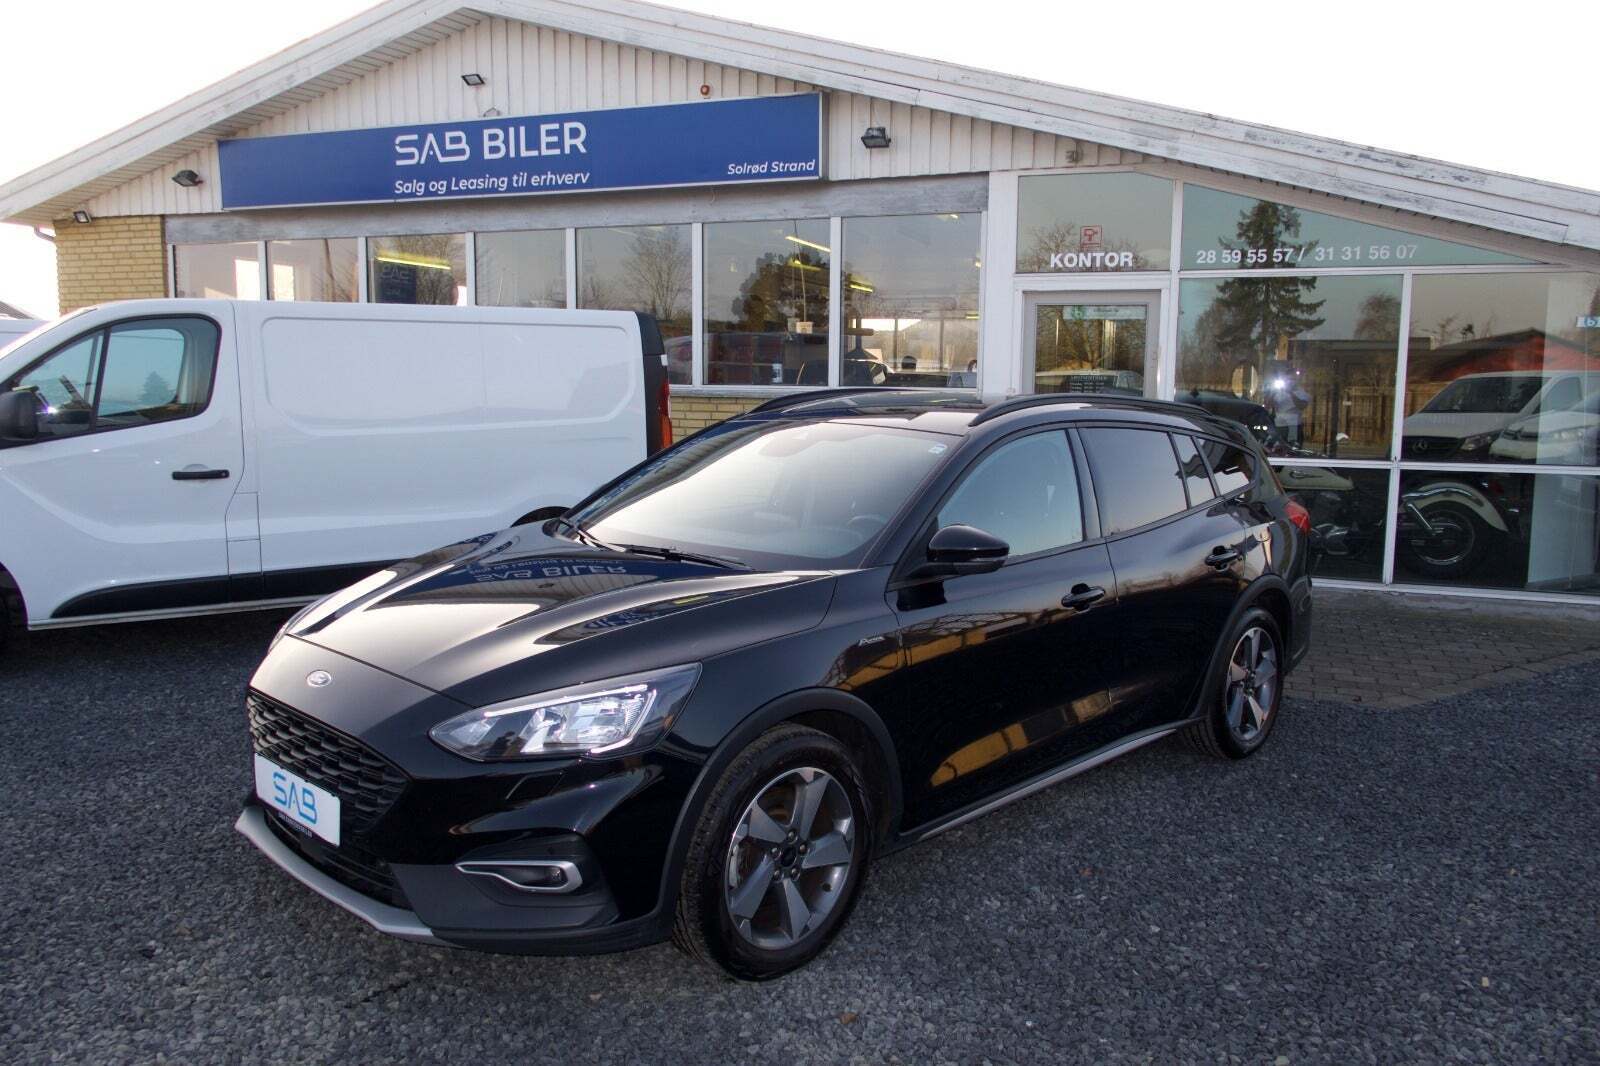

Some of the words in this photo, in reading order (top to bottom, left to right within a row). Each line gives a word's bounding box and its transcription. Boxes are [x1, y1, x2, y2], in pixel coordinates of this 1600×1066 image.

[394, 130, 471, 166] SAB
[482, 121, 588, 160] BILER
[727, 161, 768, 176] Solrød
[771, 159, 816, 173] Strand
[394, 178, 426, 196] Salg
[429, 180, 448, 194] og
[450, 173, 508, 191] Leasing
[512, 172, 528, 187] til
[530, 170, 591, 187] erhverv
[1050, 251, 1134, 268] KONTOR
[1196, 249, 1217, 264] 28
[1221, 249, 1242, 264] 59
[1246, 248, 1268, 263] 55
[1272, 247, 1294, 262] 57
[1314, 246, 1334, 261] 31
[1341, 246, 1361, 260] 31
[1368, 244, 1391, 260] 56
[1395, 244, 1418, 259] 07
[273, 771, 318, 825] SAB
